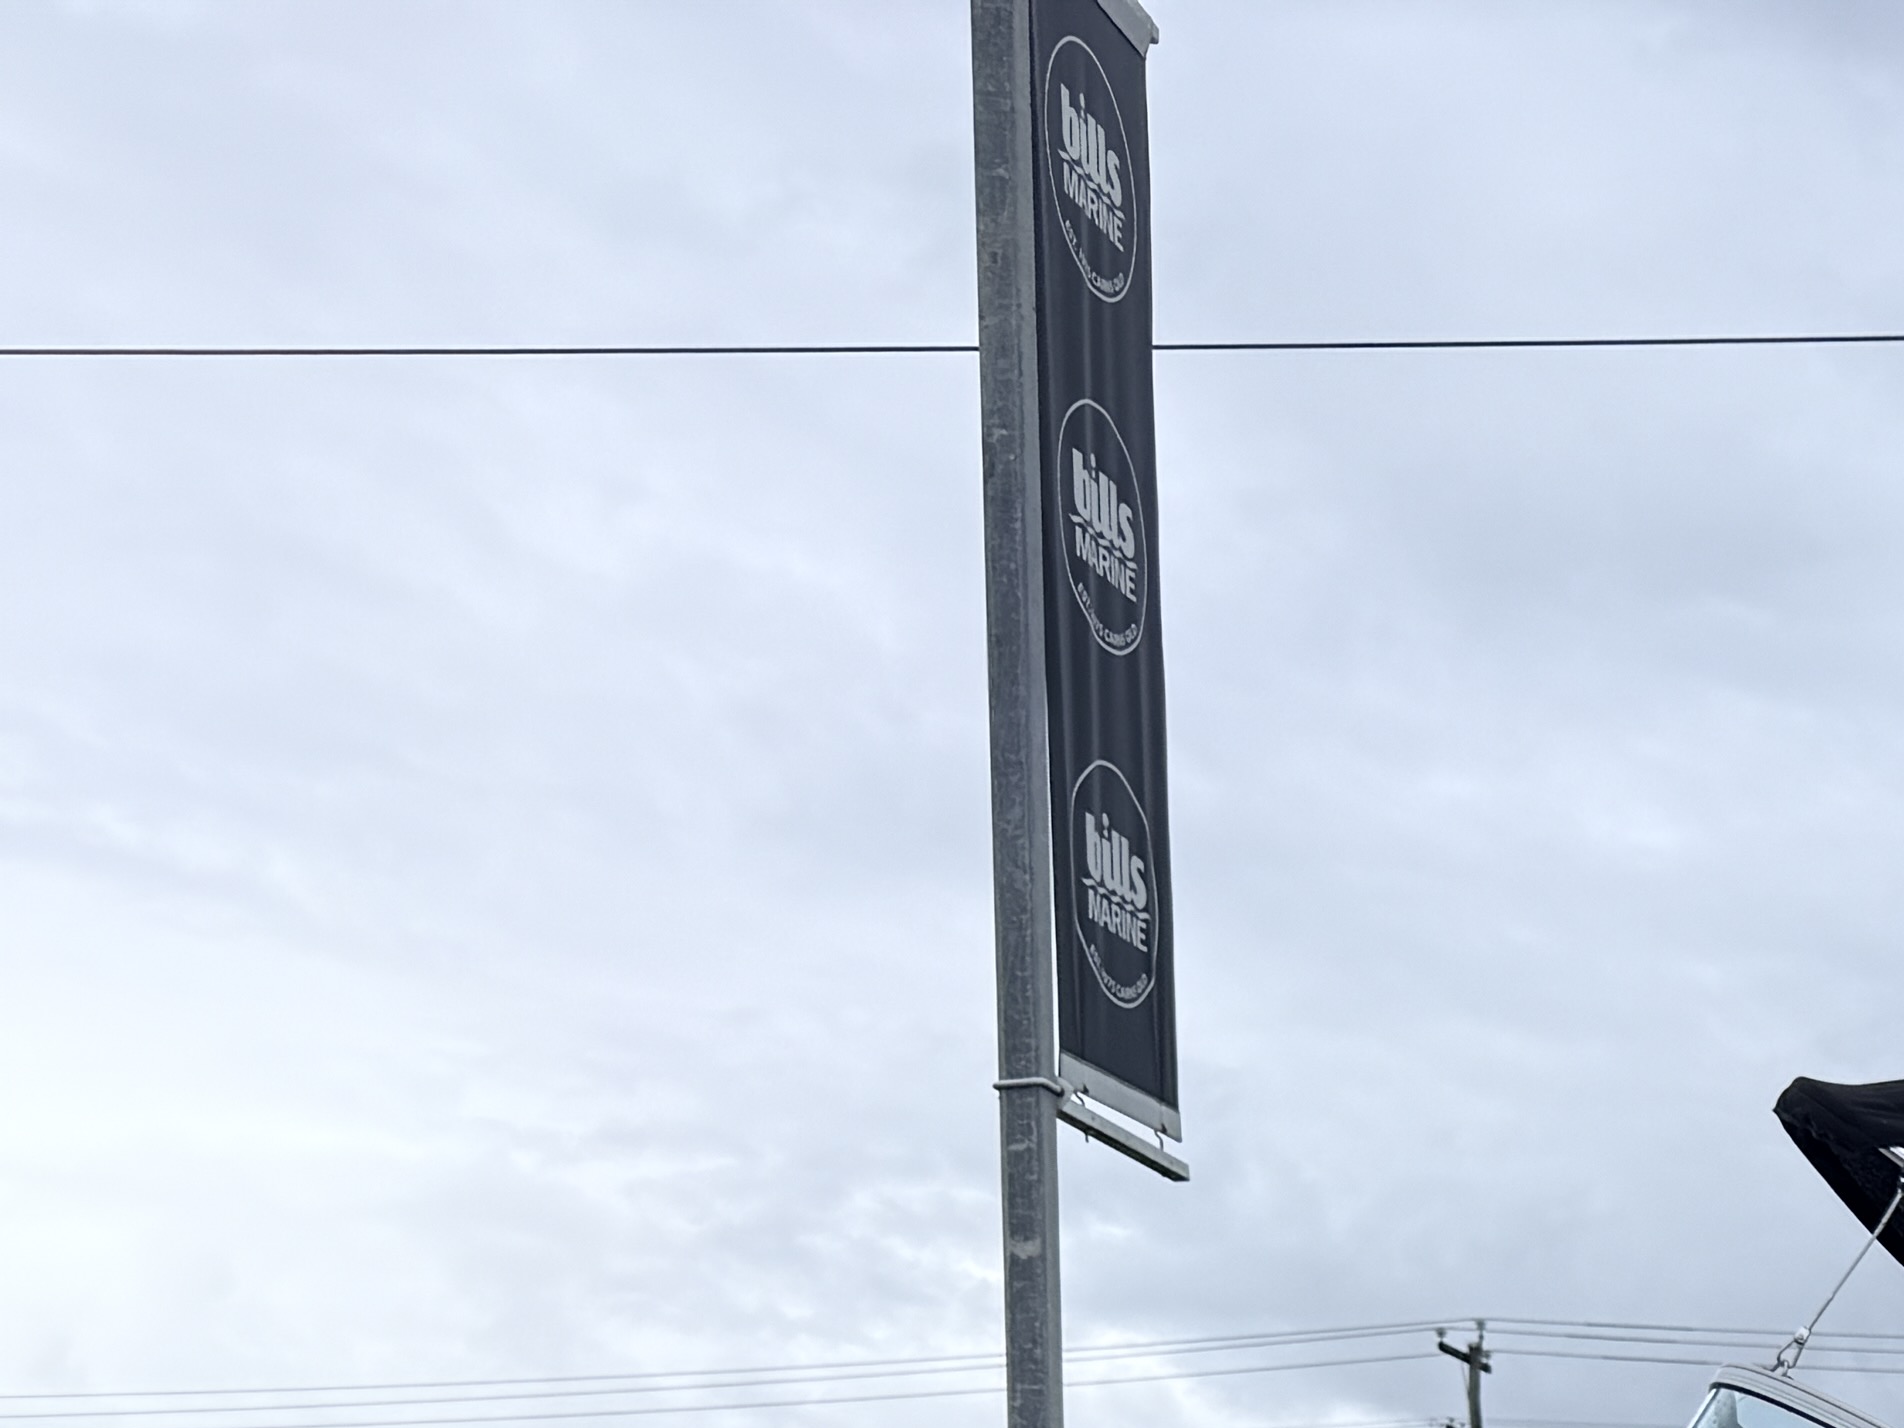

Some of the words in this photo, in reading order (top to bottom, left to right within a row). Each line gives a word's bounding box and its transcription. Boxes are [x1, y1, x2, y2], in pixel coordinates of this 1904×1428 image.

[1061, 83, 1123, 208] bills
[1063, 161, 1124, 252] MARINE
[1072, 448, 1135, 559] bills
[1075, 525, 1137, 602] MARINE
[1085, 811, 1147, 911] bills
[1088, 888, 1148, 952] MARINE
